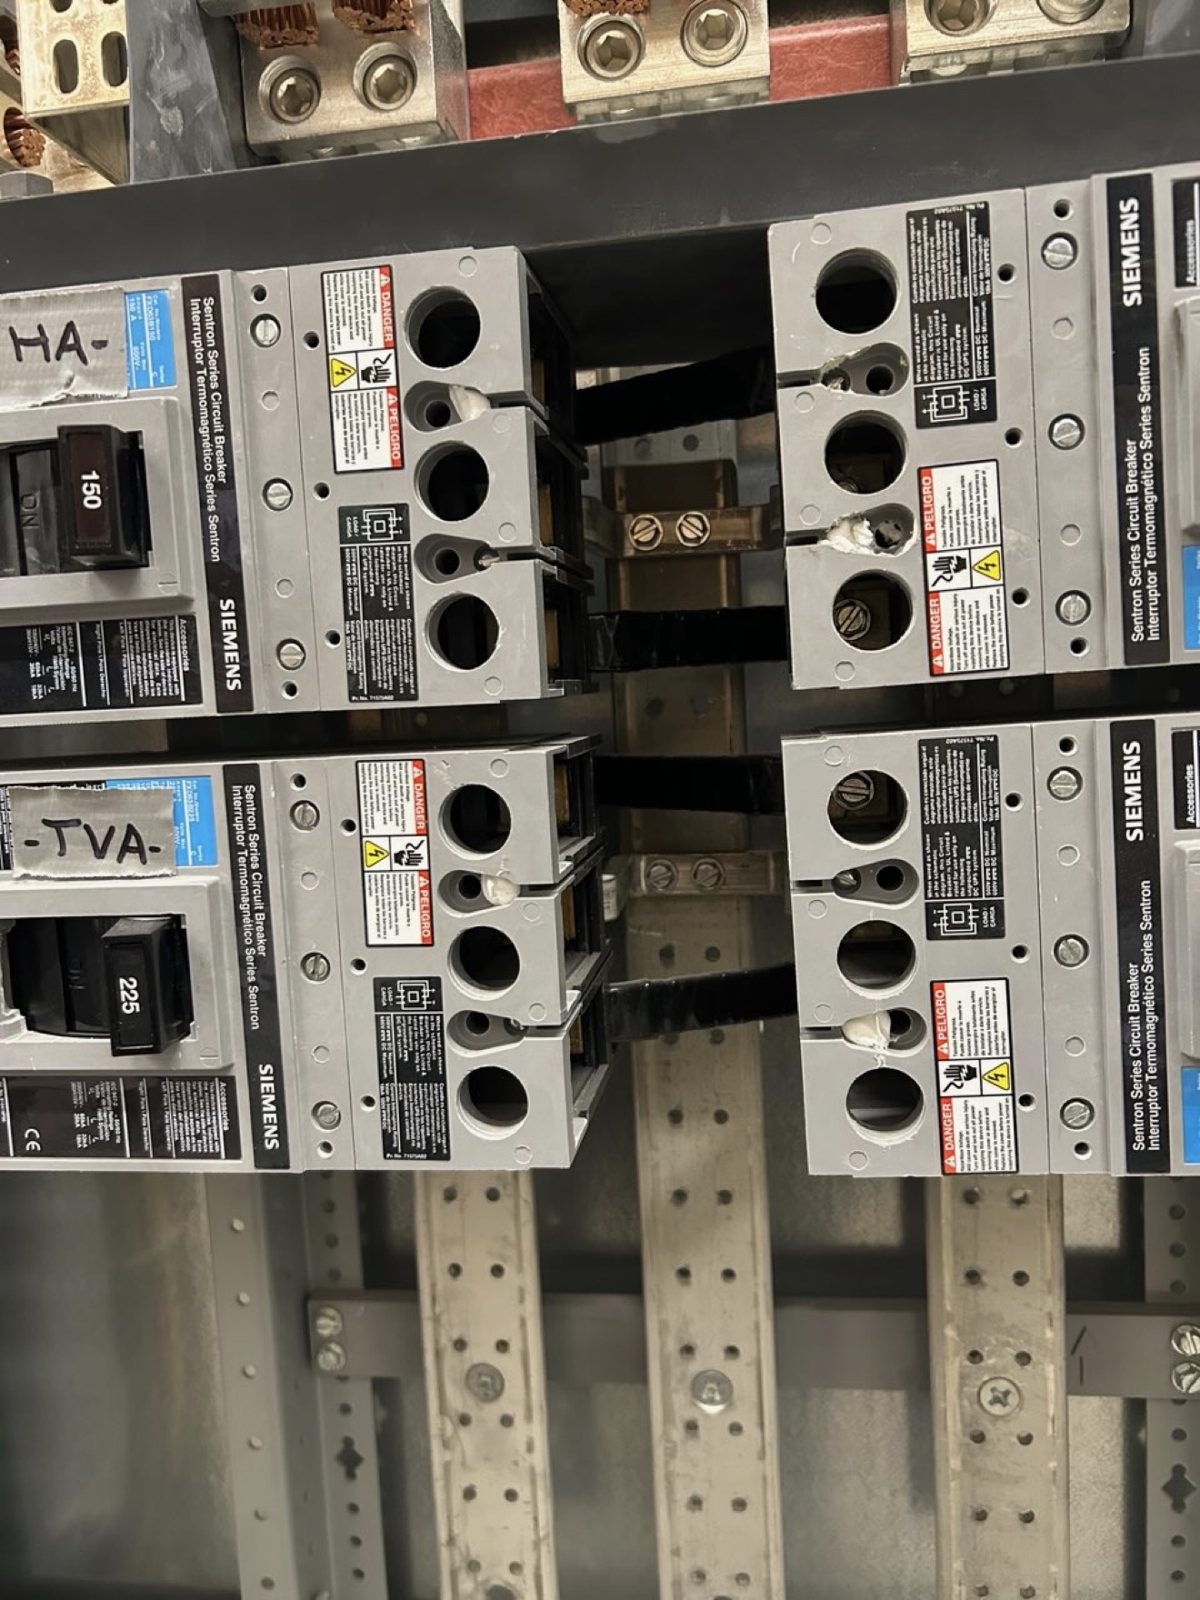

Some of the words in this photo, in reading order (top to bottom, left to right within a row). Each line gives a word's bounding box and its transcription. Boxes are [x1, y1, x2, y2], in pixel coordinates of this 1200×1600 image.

[1119, 198, 1142, 307] SIEMENS
[1186, 220, 1197, 283] Accessories
[190, 299, 204, 365] Interruptor
[203, 297, 215, 347] Sentron
[381, 291, 393, 341] DANGER
[207, 350, 220, 389] Series
[1137, 347, 1151, 403] Sentron
[196, 367, 213, 471] Termomagnético
[211, 392, 224, 433] Circuit
[388, 408, 400, 460] PELIGRO
[1139, 405, 1152, 449] Series
[214, 436, 227, 483] Breaker
[1124, 440, 1138, 493] Breaker
[81, 469, 103, 511] 150
[205, 474, 217, 512] Series
[923, 475, 935, 531] PELIGRO
[1141, 452, 1157, 567] Termomagnético
[208, 515, 220, 562] Sentron
[1126, 497, 1140, 541] Circuit
[1129, 544, 1142, 586] Series
[930, 597, 942, 649] DANGER
[1131, 590, 1144, 642] Sentron
[1146, 570, 1161, 640] Interruptor
[180, 619, 190, 672] Accessories
[220, 599, 241, 690] SIEMENS
[244, 785, 256, 830] Sentron
[414, 783, 425, 829] DANGER
[1123, 741, 1143, 841] SIEMENS
[1185, 764, 1195, 823] Accessories
[232, 786, 245, 846] Interruptor
[25, 818, 161, 866] -TVA-
[249, 833, 260, 869] Series
[237, 849, 254, 945] Termomagnético
[252, 872, 264, 910] Circuit
[420, 890, 430, 937] PELIGRO
[1140, 881, 1152, 930] Sentron
[255, 913, 267, 957] Breaker
[1141, 933, 1154, 973] Series
[245, 947, 256, 982] Series
[1127, 963, 1140, 1012] Breaker
[119, 976, 140, 1015] 225
[248, 986, 259, 1030] Sentron
[936, 989, 948, 1040] PELIGRO
[1128, 1016, 1141, 1057] Circuit
[1142, 976, 1159, 1082] Termomagnético
[1130, 1060, 1143, 1099] Series
[219, 1082, 229, 1131] Accessories
[259, 1064, 279, 1149] SIEMENS
[943, 1103, 954, 1150] DANGER
[1133, 1102, 1145, 1150] Sentron
[1147, 1084, 1161, 1150] Interruptor
